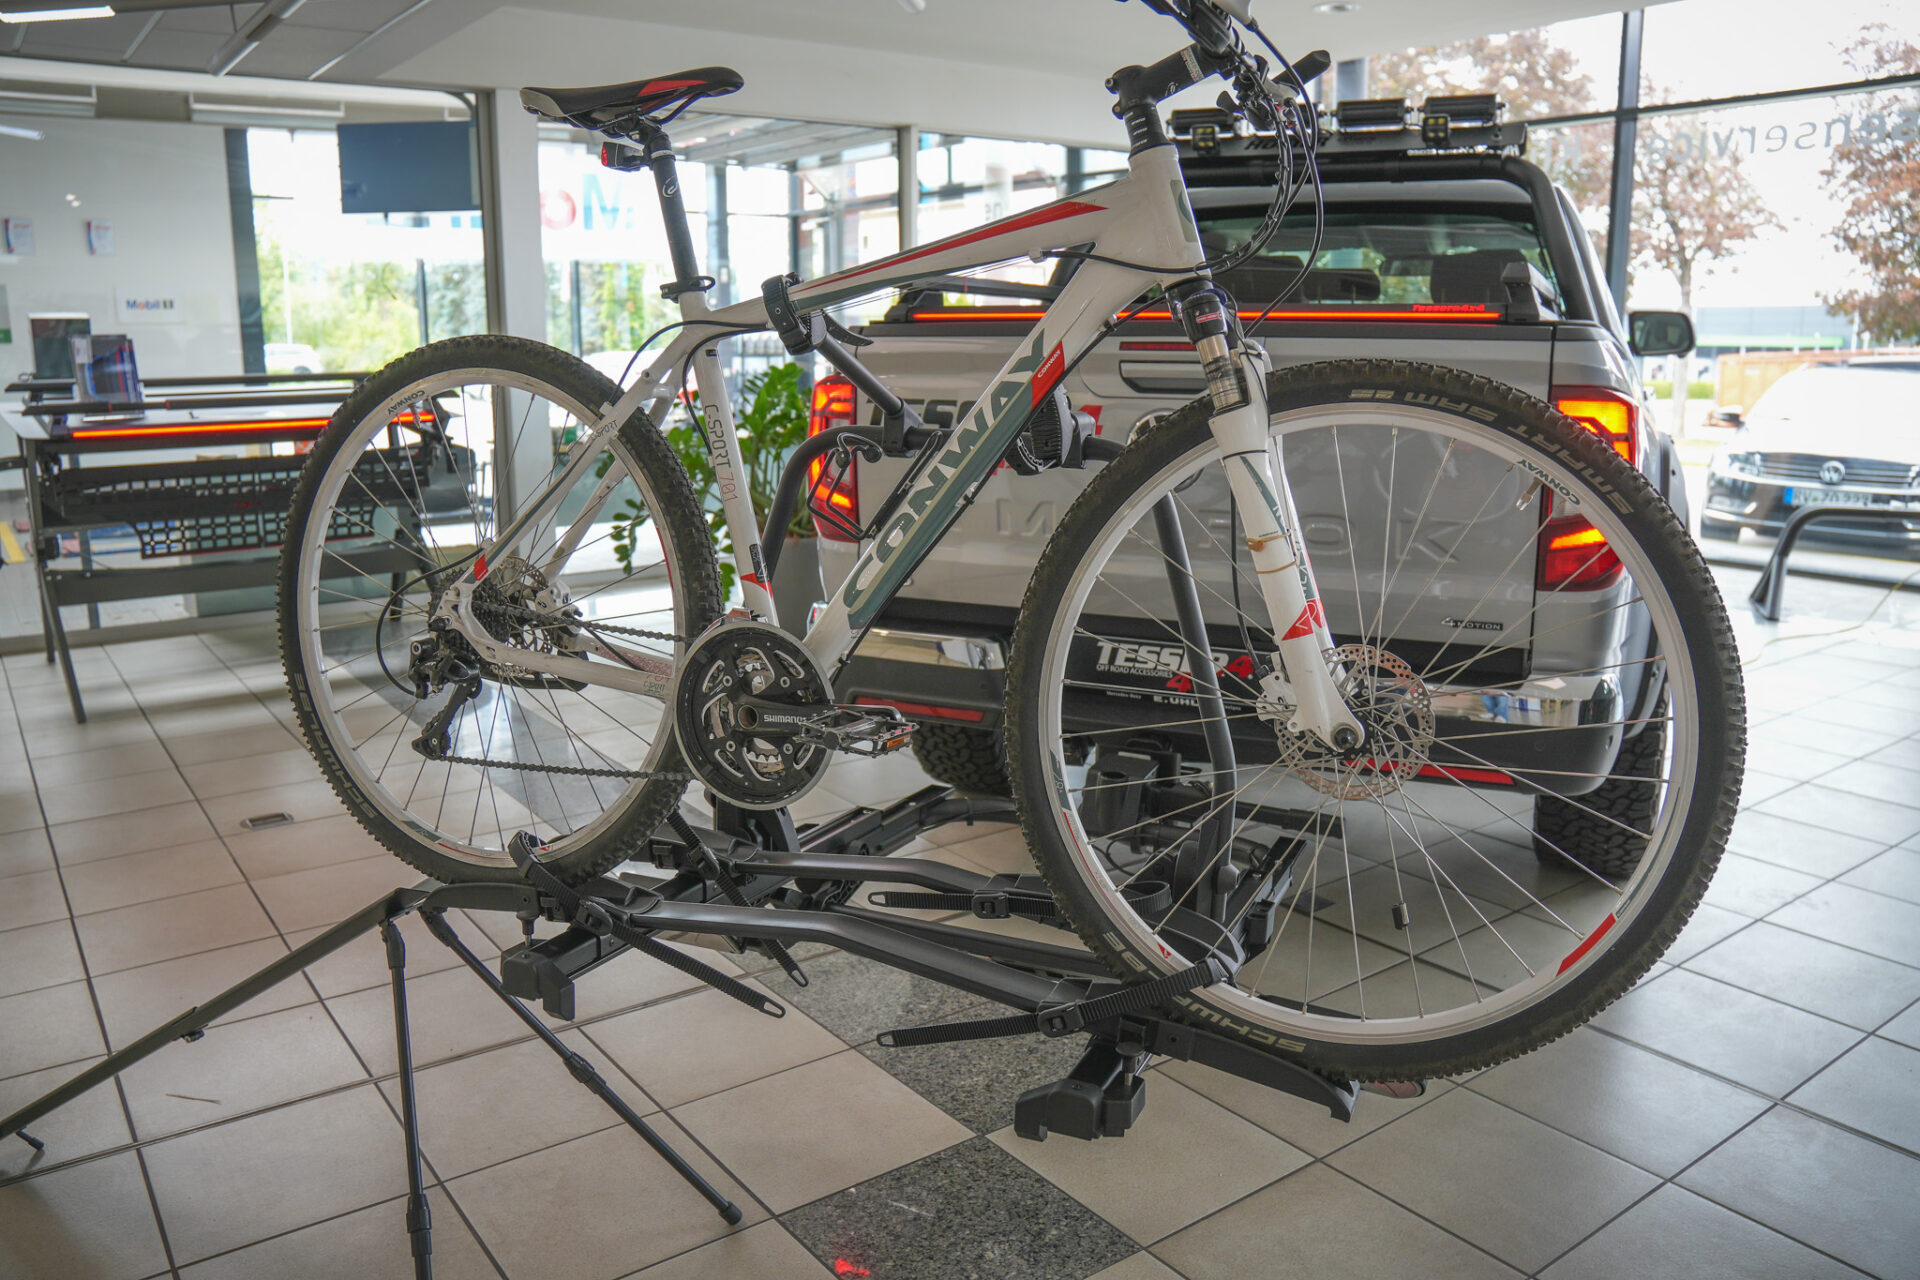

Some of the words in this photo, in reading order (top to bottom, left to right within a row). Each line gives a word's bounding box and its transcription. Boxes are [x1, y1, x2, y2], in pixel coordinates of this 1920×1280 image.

[126, 299, 160, 310] Mobil
[1037, 348, 1061, 379] CONWAY
[387, 389, 426, 415] CONWAY
[1403, 391, 1498, 422] SAM
[704, 404, 732, 469] C-SPORT
[843, 328, 1045, 608] CONWAY
[1506, 424, 1635, 516] SMART
[1516, 458, 1581, 506] CONWAY
[1096, 664, 1109, 672] OFF
[1110, 665, 1129, 674] ROAD
[1130, 667, 1173, 679] ACCESSORIES
[294, 673, 379, 819] SCHWALBE
